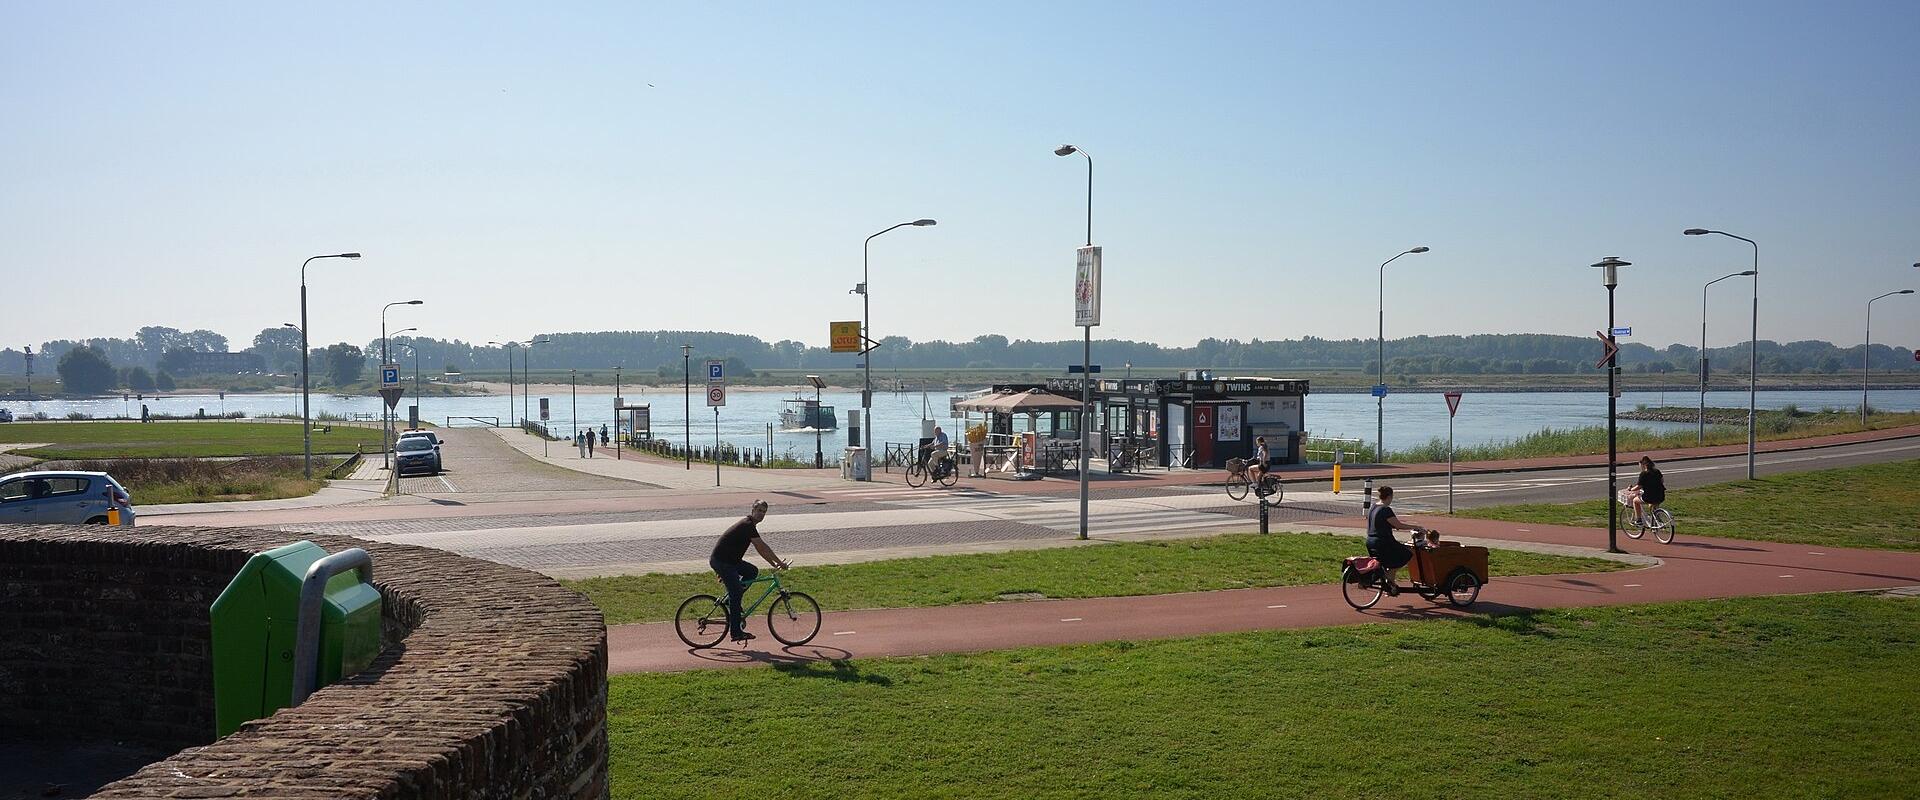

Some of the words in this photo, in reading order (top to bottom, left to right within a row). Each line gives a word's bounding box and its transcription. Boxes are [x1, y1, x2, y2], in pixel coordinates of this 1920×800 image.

[1076, 310, 1092, 318] TIEL
[387, 371, 395, 381] P
[713, 367, 720, 377] P
[1105, 382, 1118, 390] TWINS
[1226, 383, 1251, 392] TWINS
